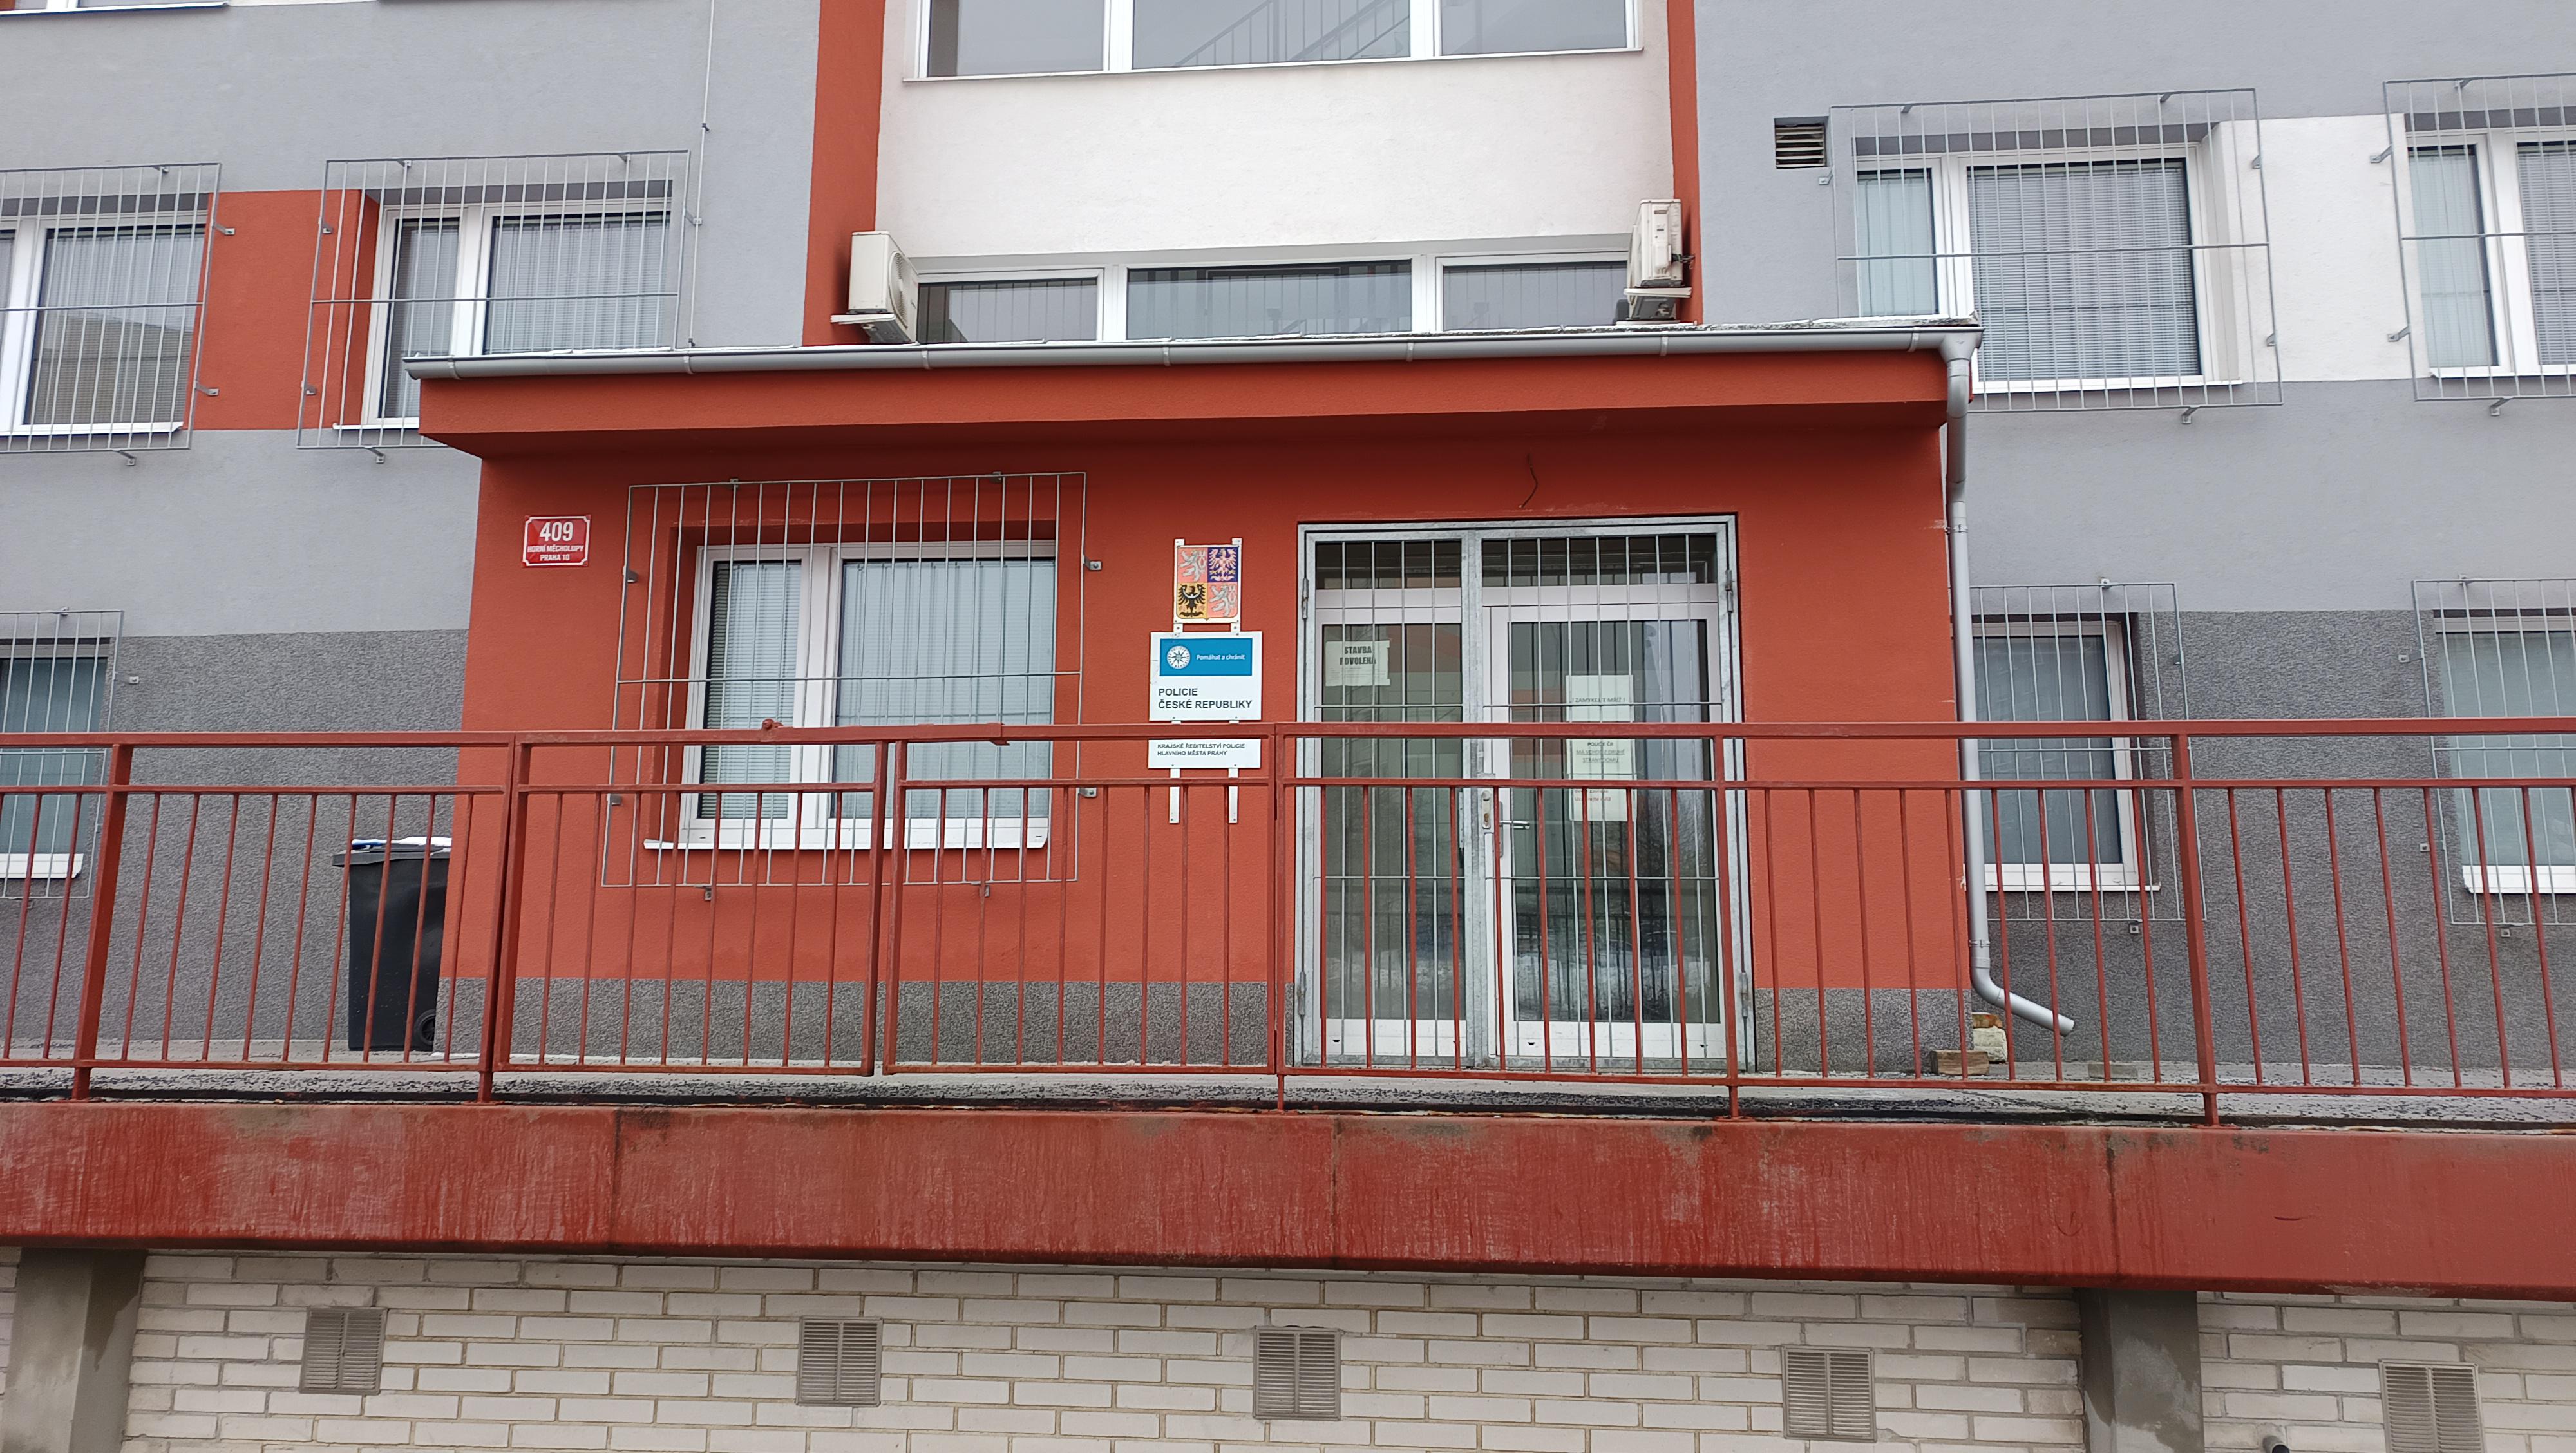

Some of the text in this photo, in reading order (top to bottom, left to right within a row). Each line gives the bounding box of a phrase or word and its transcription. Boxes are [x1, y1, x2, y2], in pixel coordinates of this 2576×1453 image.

[540, 522, 573, 541] 409
[1158, 699, 1252, 708] ČESKÉ REPUBLIKY
